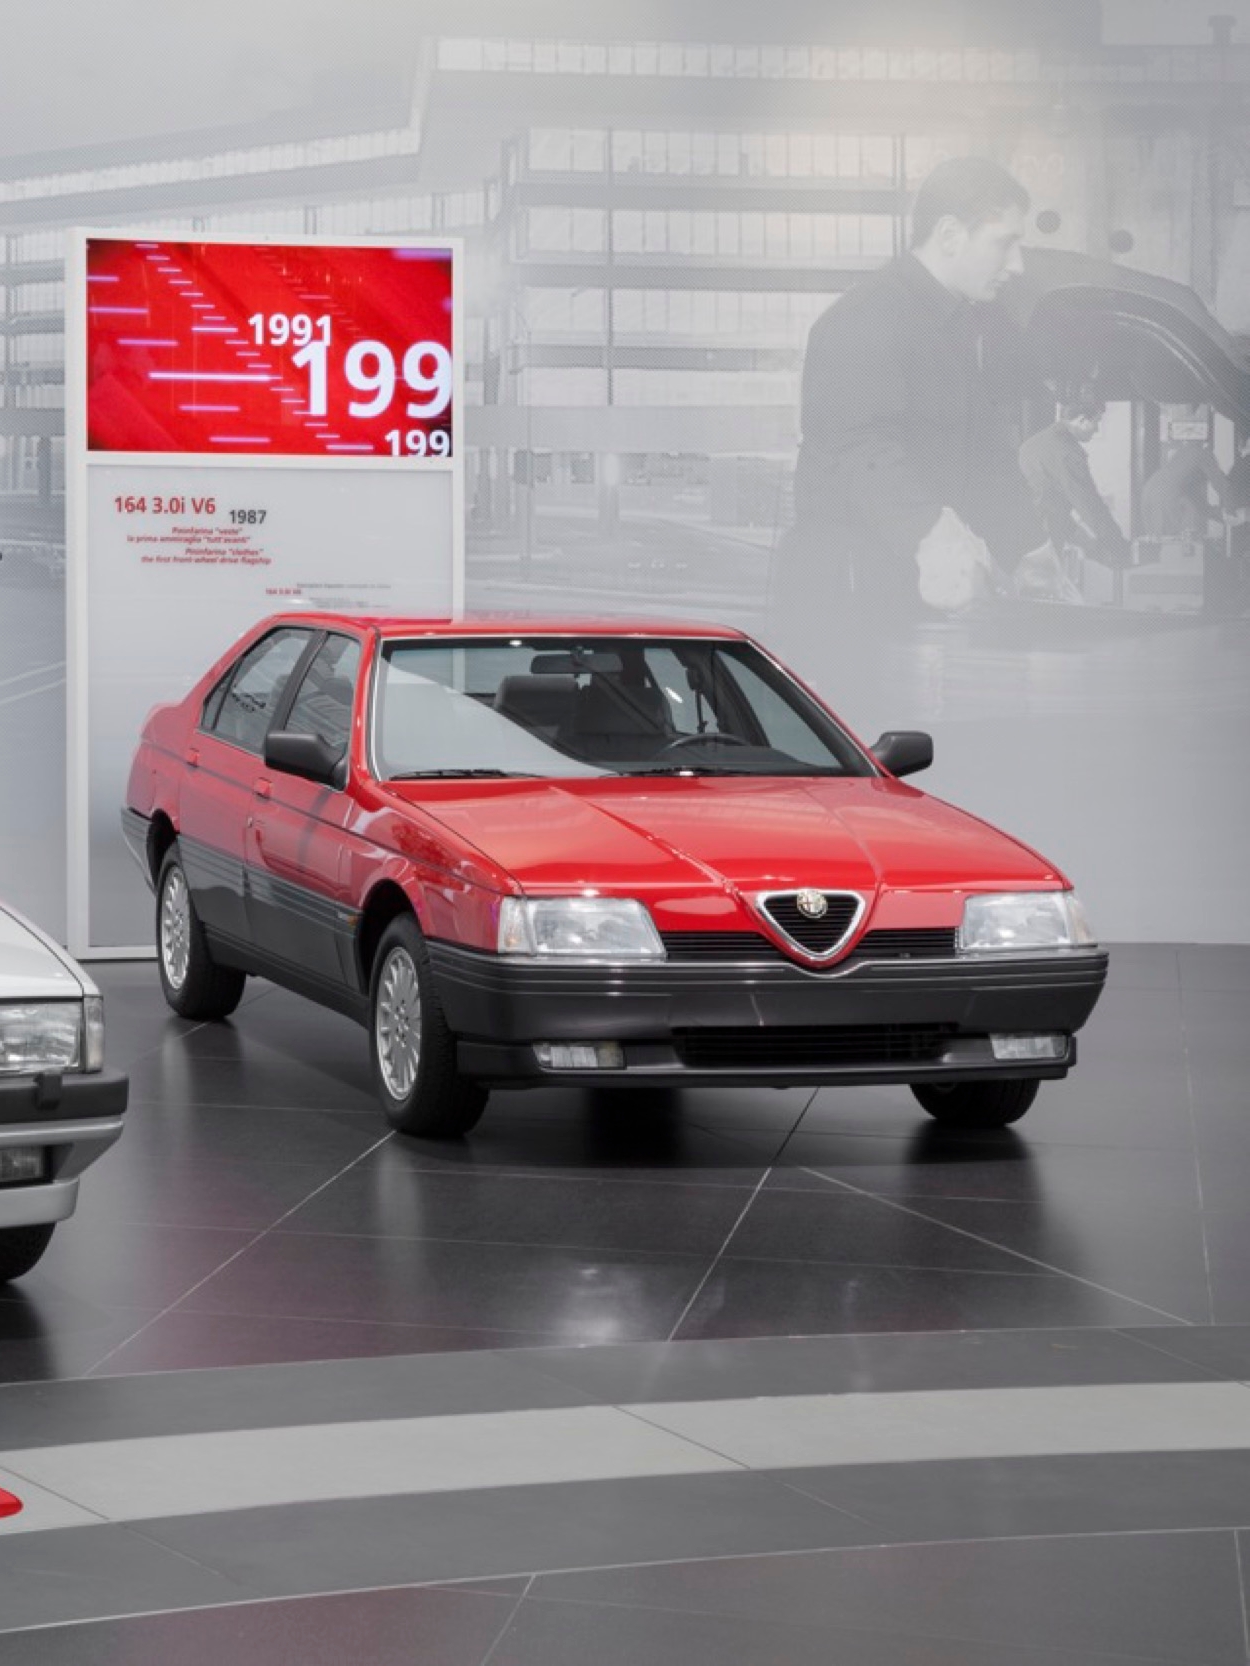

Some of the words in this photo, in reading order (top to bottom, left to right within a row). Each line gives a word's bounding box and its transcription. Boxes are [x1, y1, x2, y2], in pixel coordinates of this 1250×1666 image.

[248, 313, 331, 347] 1991
[114, 496, 147, 513] 164
[152, 496, 185, 514] 3.0i
[191, 497, 216, 515] V6
[229, 509, 267, 524] 1987
